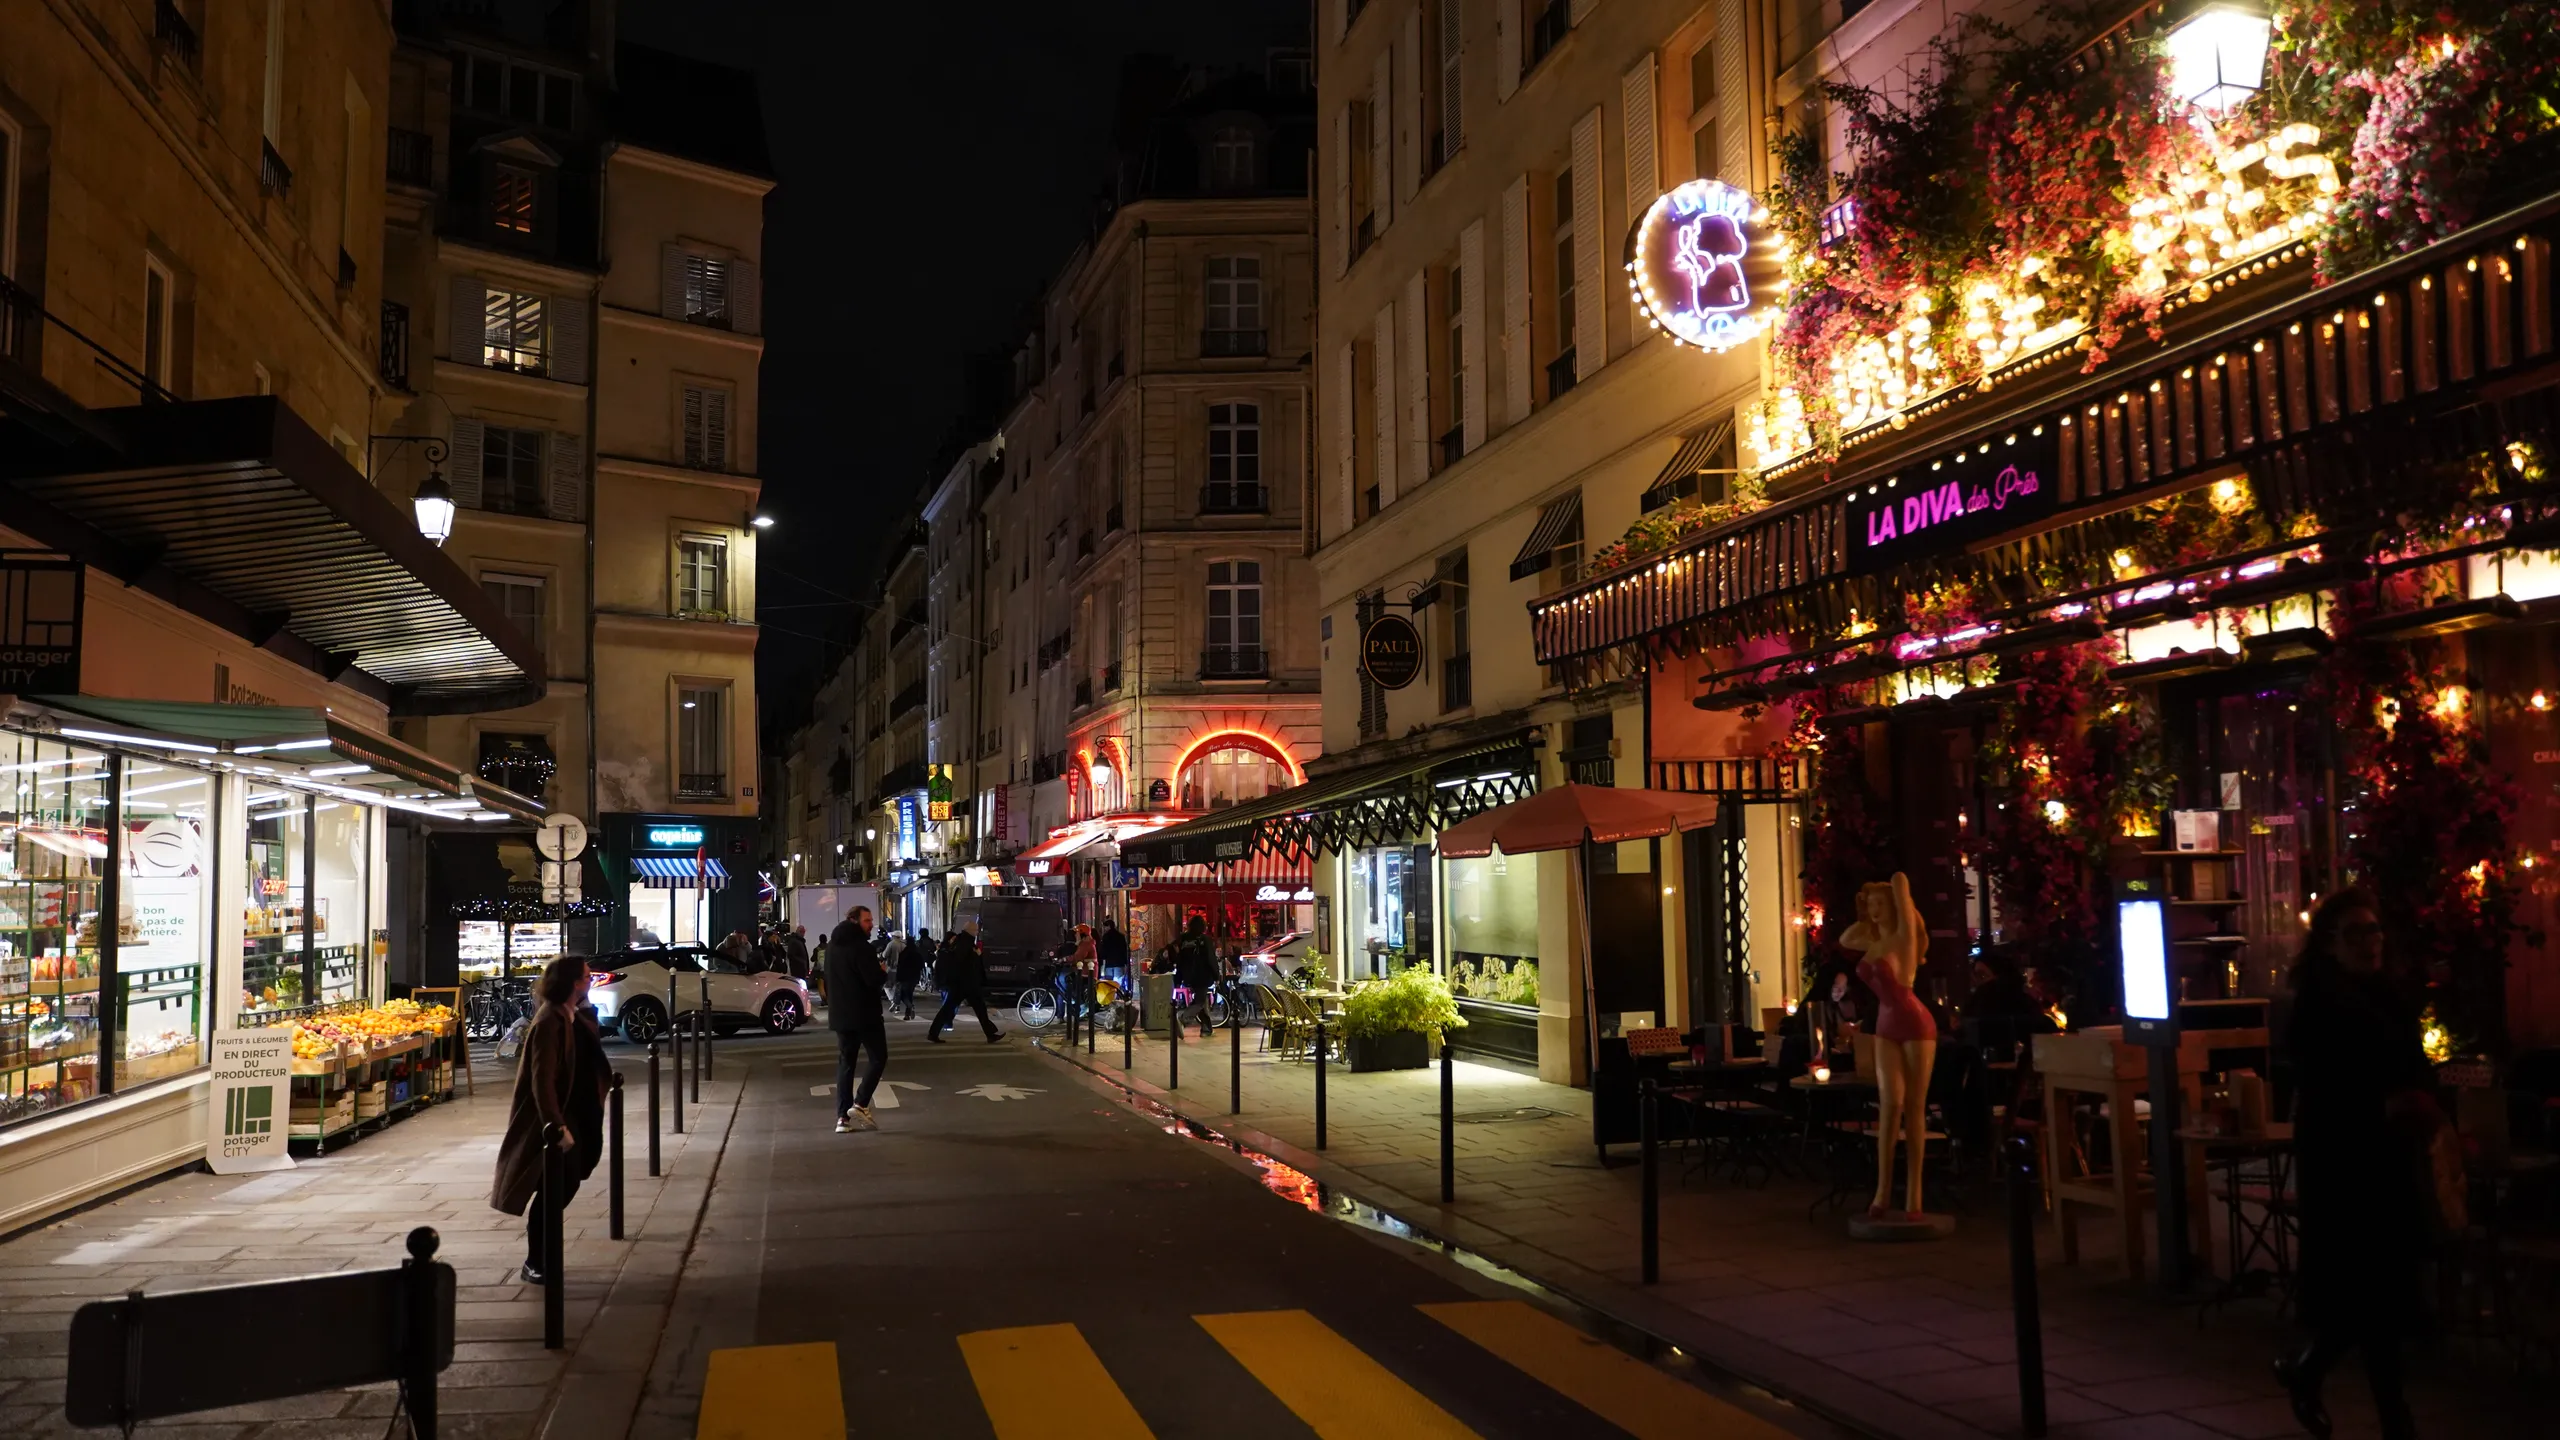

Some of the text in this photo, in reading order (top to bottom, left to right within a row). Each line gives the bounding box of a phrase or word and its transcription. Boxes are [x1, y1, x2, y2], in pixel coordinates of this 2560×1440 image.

[1867, 505, 1897, 547] LA
[1903, 480, 1964, 535] DIVA
[1966, 484, 1990, 514] des
[1370, 640, 1417, 654] PAUL
[0, 649, 72, 668] otager
[1, 668, 36, 686] ITY
[1579, 759, 1614, 785] PAUL
[744, 788, 753, 796] 18
[902, 801, 914, 854] PRESSI
[998, 804, 1006, 840] STREET
[508, 885, 544, 895] Botte
[1256, 885, 1315, 901] Bar du
[143, 906, 165, 915] bon
[146, 918, 167, 927] pas
[170, 916, 185, 925] de
[216, 1037, 243, 1046] FRUITS
[252, 1036, 288, 1044] LÉGUMES
[224, 1048, 280, 1060] EN DIRECT
[244, 1060, 259, 1069] DU
[214, 1068, 287, 1080] PRODUCTEUR
[224, 1134, 271, 1148] potager
[223, 1146, 251, 1158] CITY
